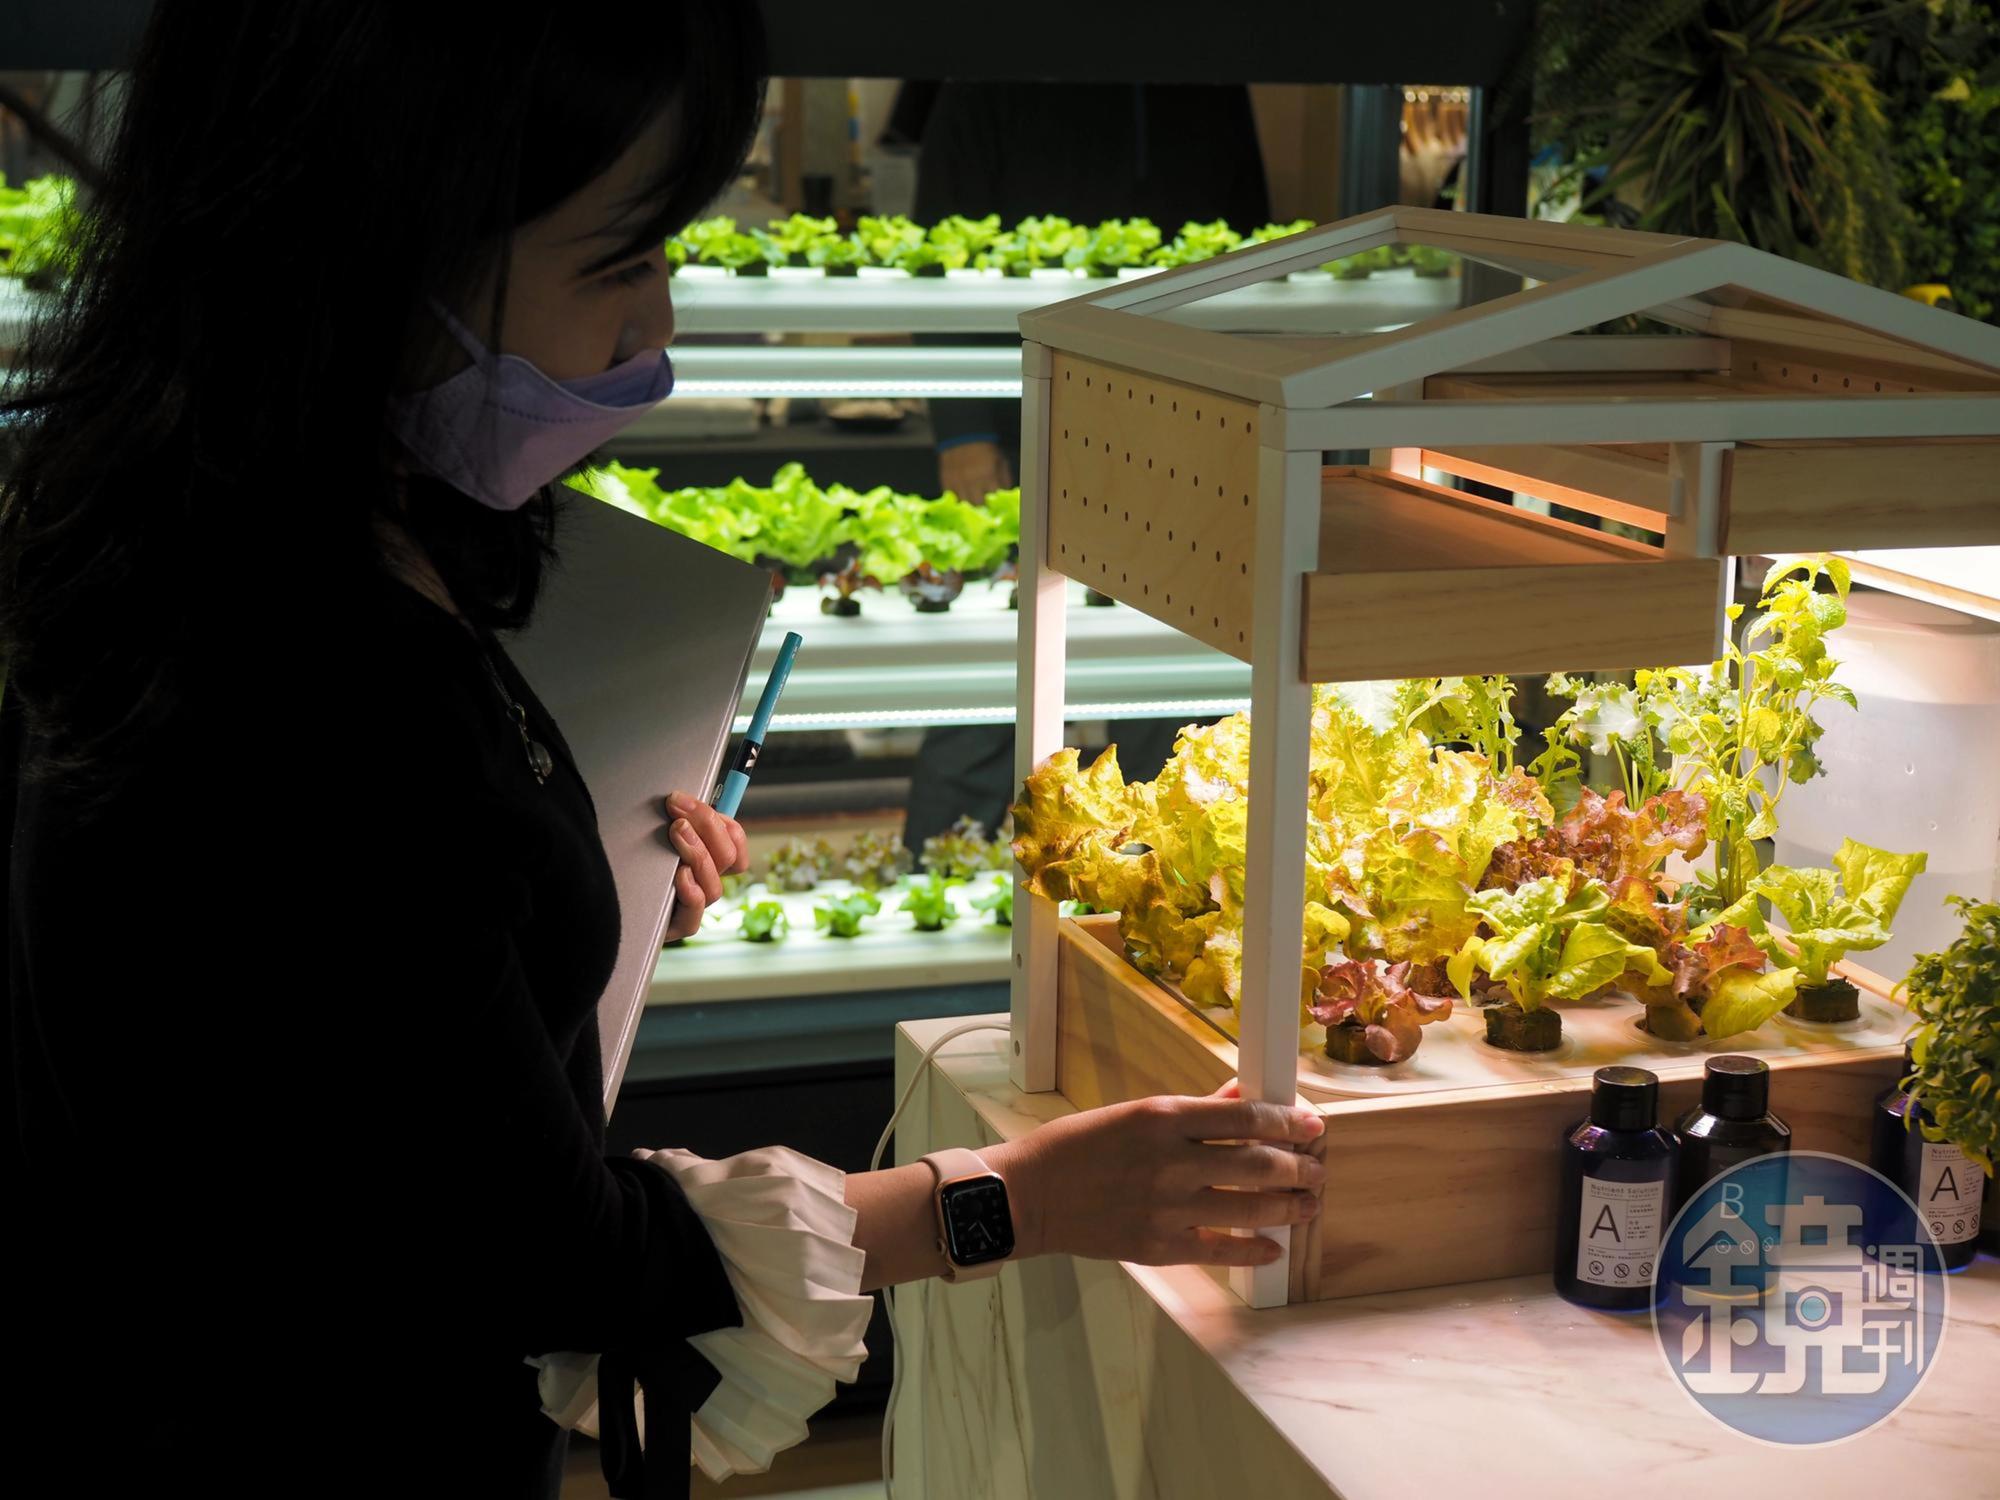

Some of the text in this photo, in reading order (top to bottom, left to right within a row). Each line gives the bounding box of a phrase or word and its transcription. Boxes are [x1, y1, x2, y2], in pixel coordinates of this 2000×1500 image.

[1591, 1184, 1658, 1194] Nutrient Solution
[1720, 1182, 1744, 1219] B
[1930, 1166, 1959, 1201] A
[1589, 1204, 1621, 1243] A
